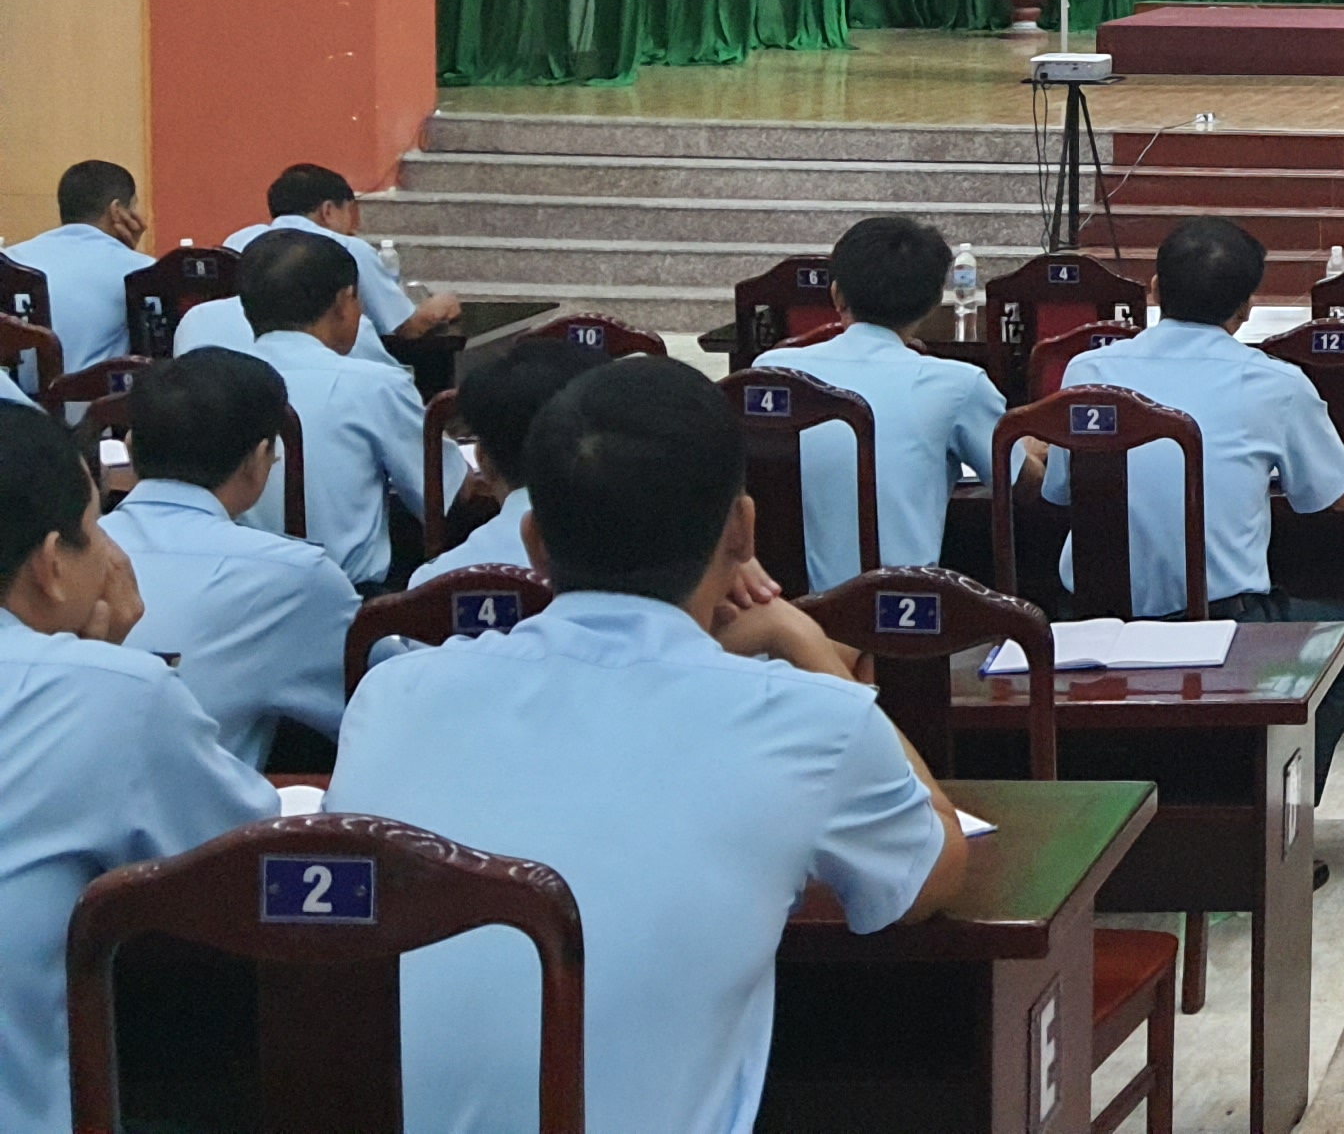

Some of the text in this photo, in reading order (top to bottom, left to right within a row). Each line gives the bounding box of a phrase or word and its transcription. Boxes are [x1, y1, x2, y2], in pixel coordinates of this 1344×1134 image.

[809, 270, 818, 285] 6
[1058, 266, 1068, 280] 4
[577, 328, 597, 345] 10
[1320, 333, 1340, 350] 12
[760, 390, 774, 412] 4
[1087, 409, 1101, 430] 2
[477, 597, 498, 626] 4
[898, 598, 917, 628] 2
[302, 865, 334, 913] 2
